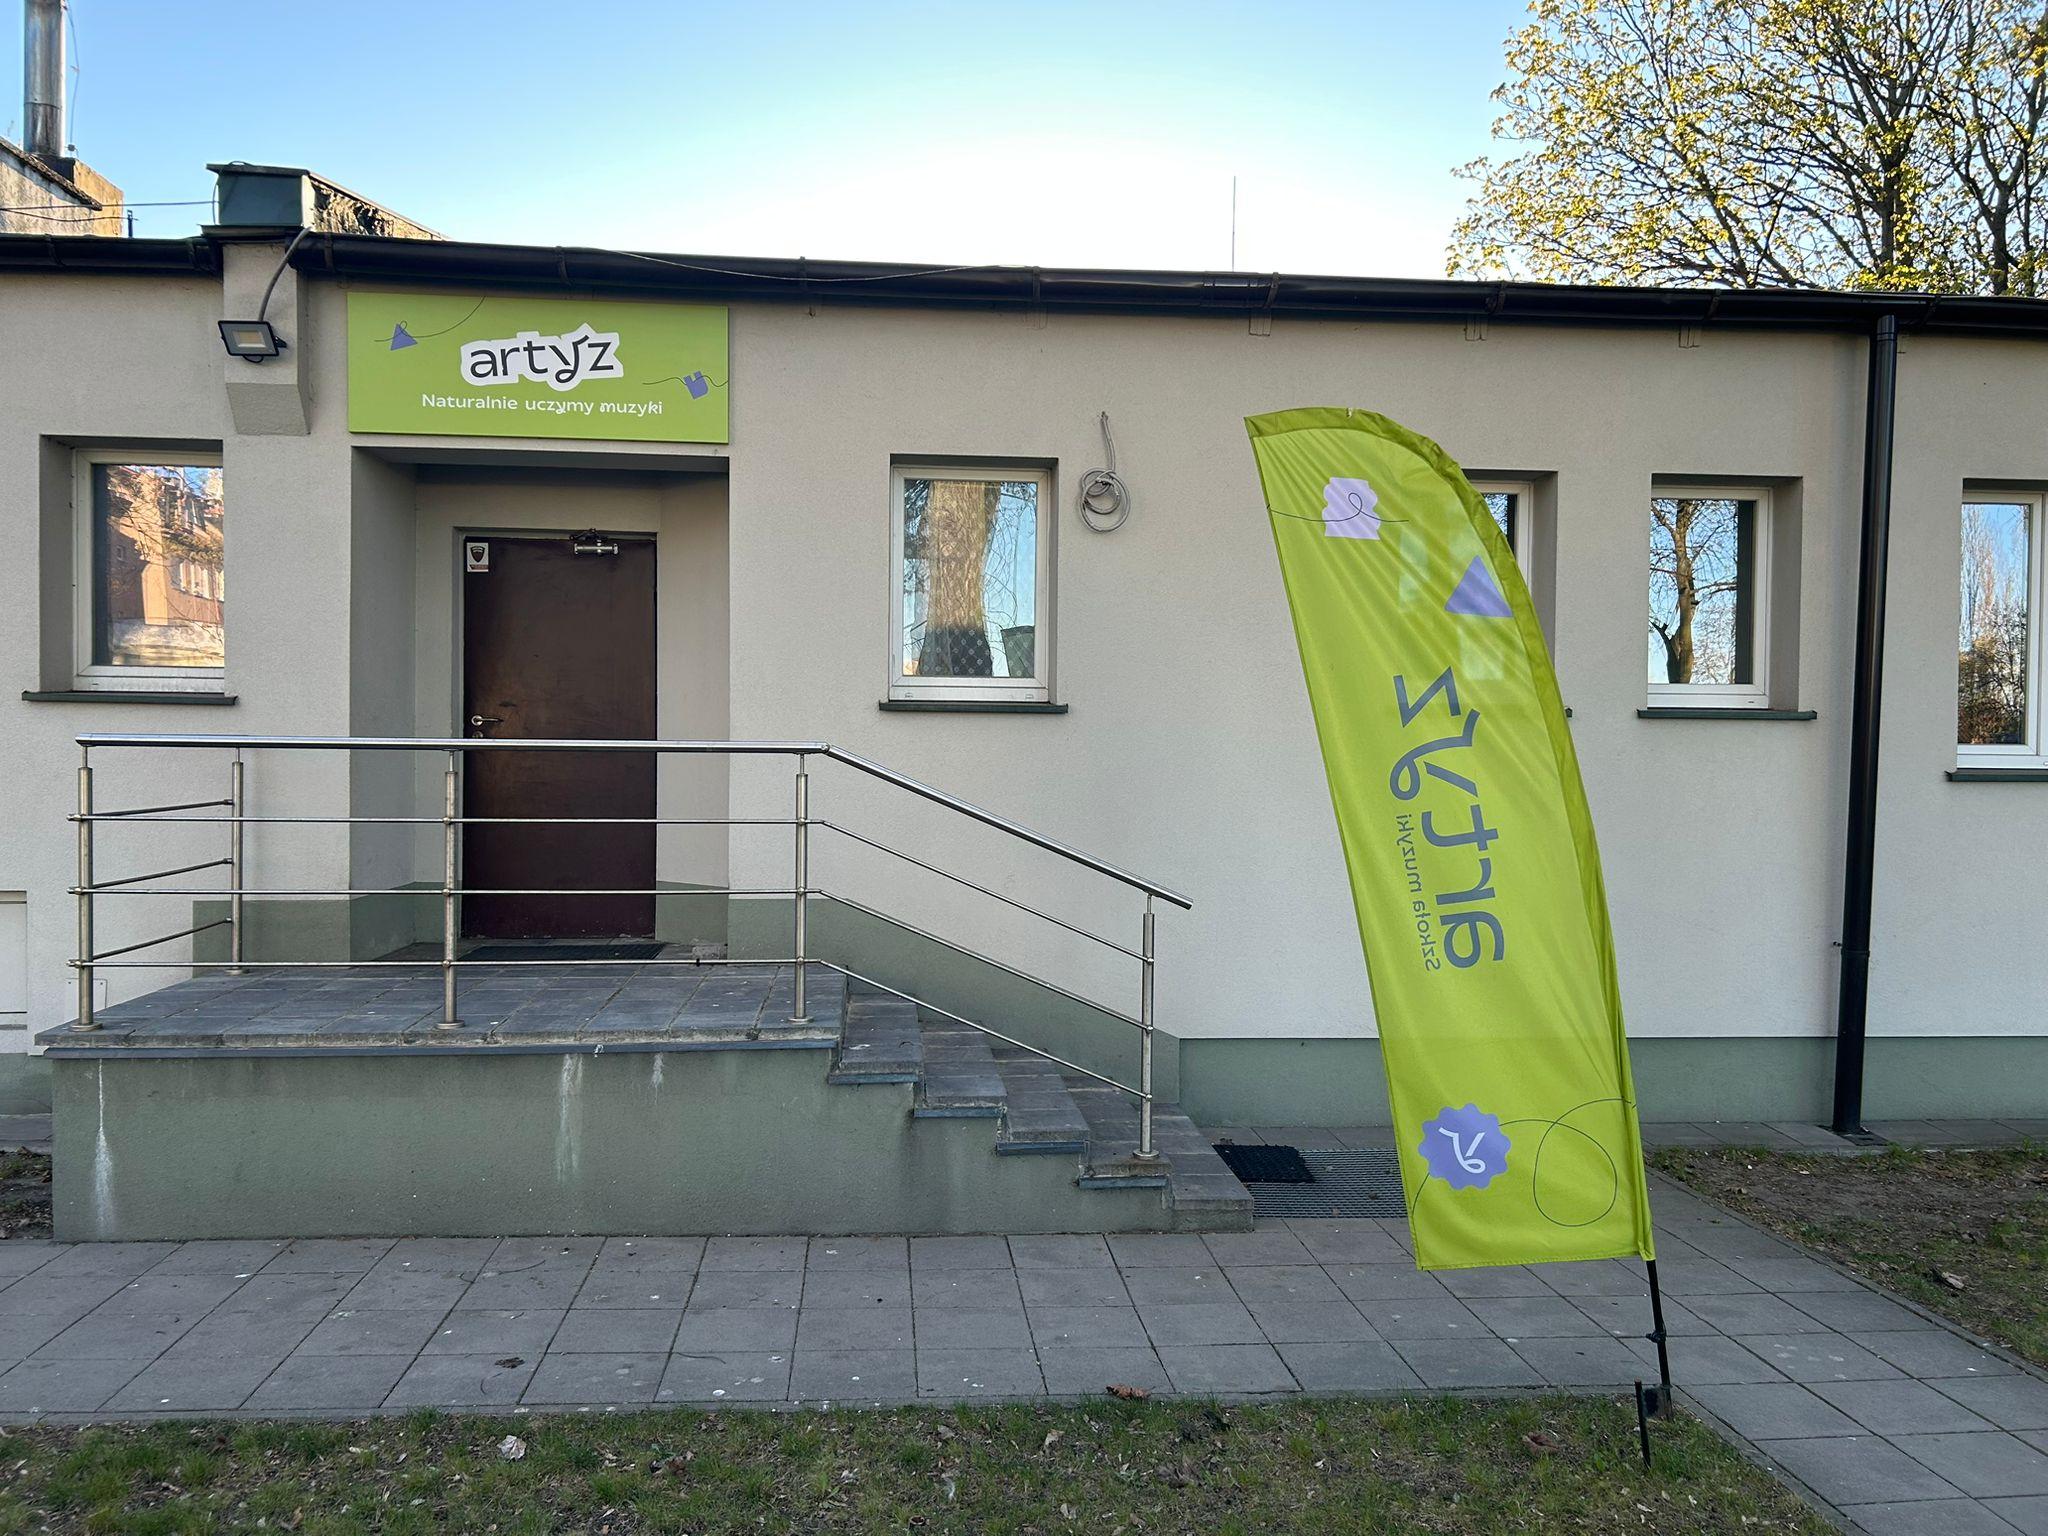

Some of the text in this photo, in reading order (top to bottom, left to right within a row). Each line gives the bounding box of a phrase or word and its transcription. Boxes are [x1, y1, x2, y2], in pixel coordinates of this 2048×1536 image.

[469, 334, 614, 384] artyz
[421, 393, 663, 417] Naturalnie uczymy muzyki
